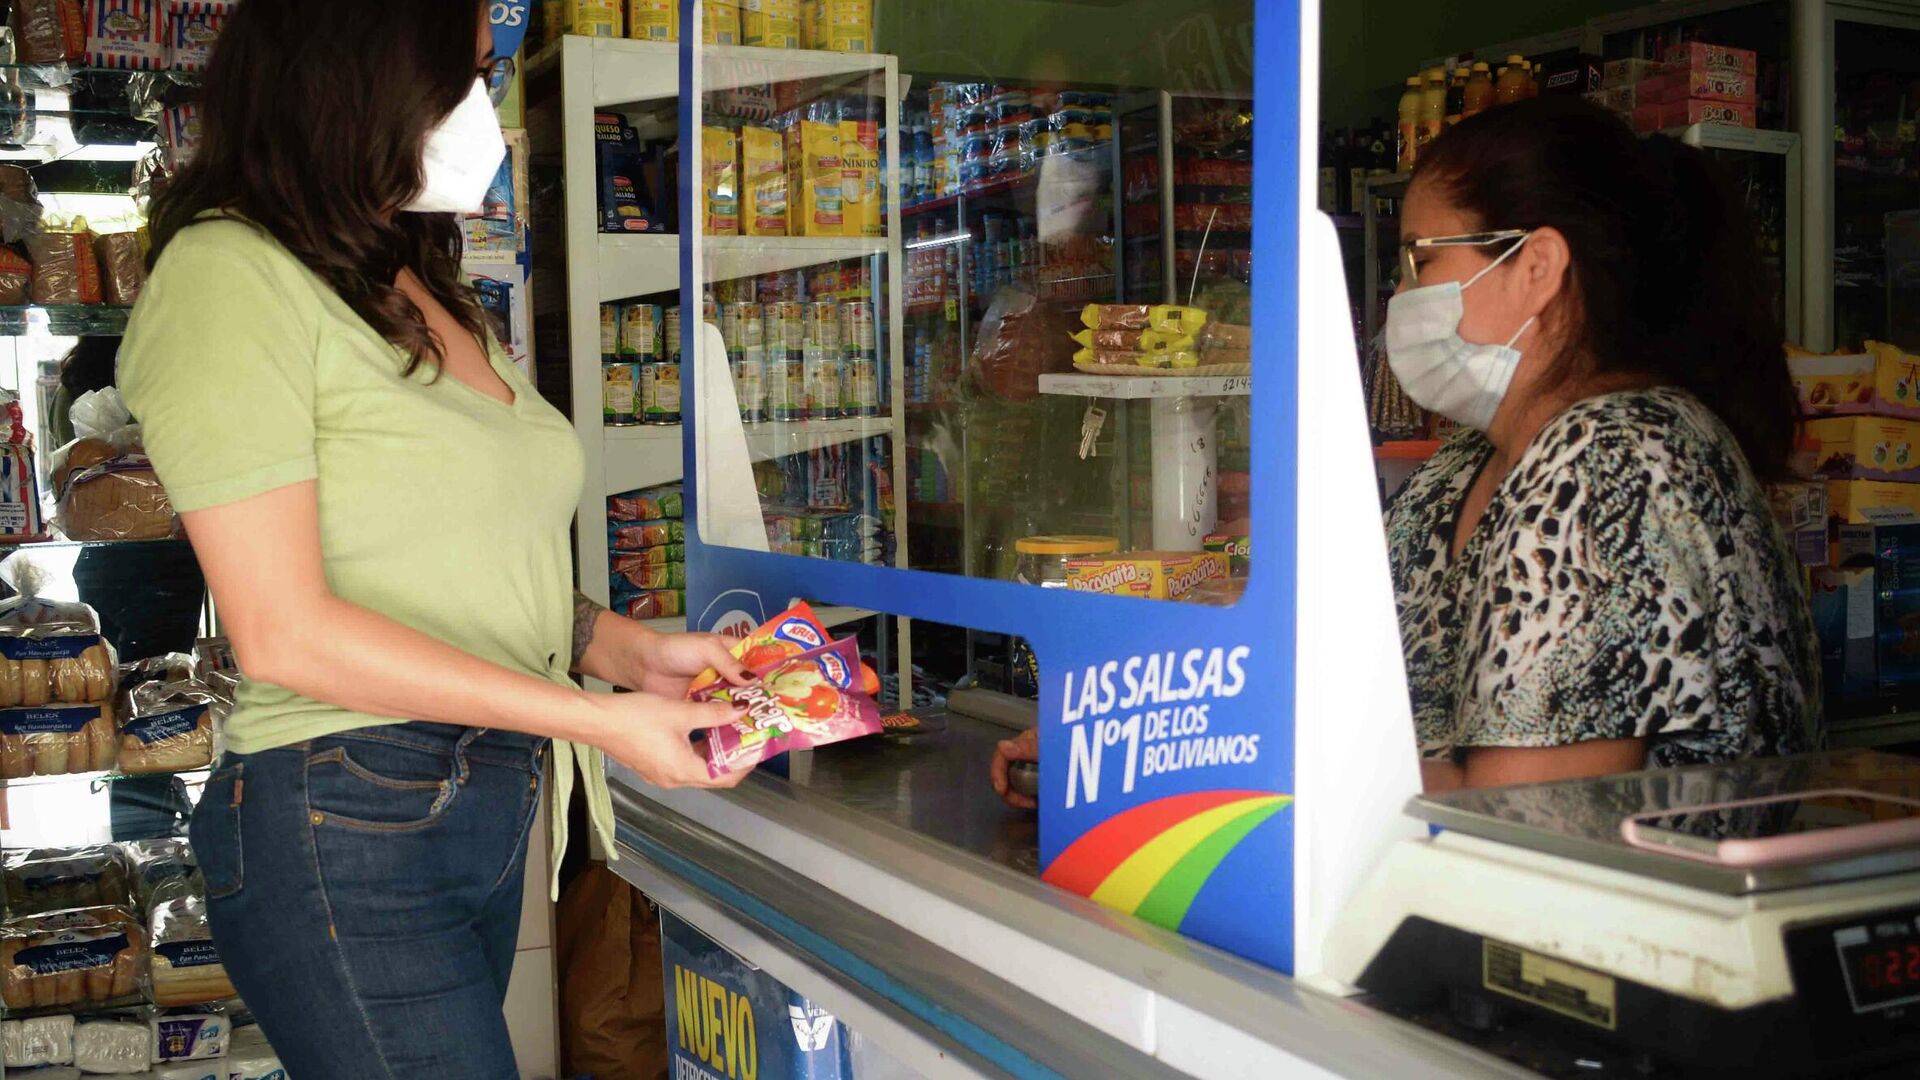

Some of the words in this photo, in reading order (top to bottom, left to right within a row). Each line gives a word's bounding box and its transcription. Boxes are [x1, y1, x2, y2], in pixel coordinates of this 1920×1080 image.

[596, 125, 620, 133] QUESO
[843, 159, 879, 168] NINHO
[789, 624, 817, 642] KRIS
[823, 656, 843, 681] KRIS
[1062, 660, 1118, 725] LAS
[1119, 645, 1250, 710] SALSAS
[1143, 707, 1171, 742] DE
[1171, 703, 1210, 737] LOS
[1142, 733, 1260, 777] BOLIVIANOS
[674, 964, 757, 1080] NUEVO
